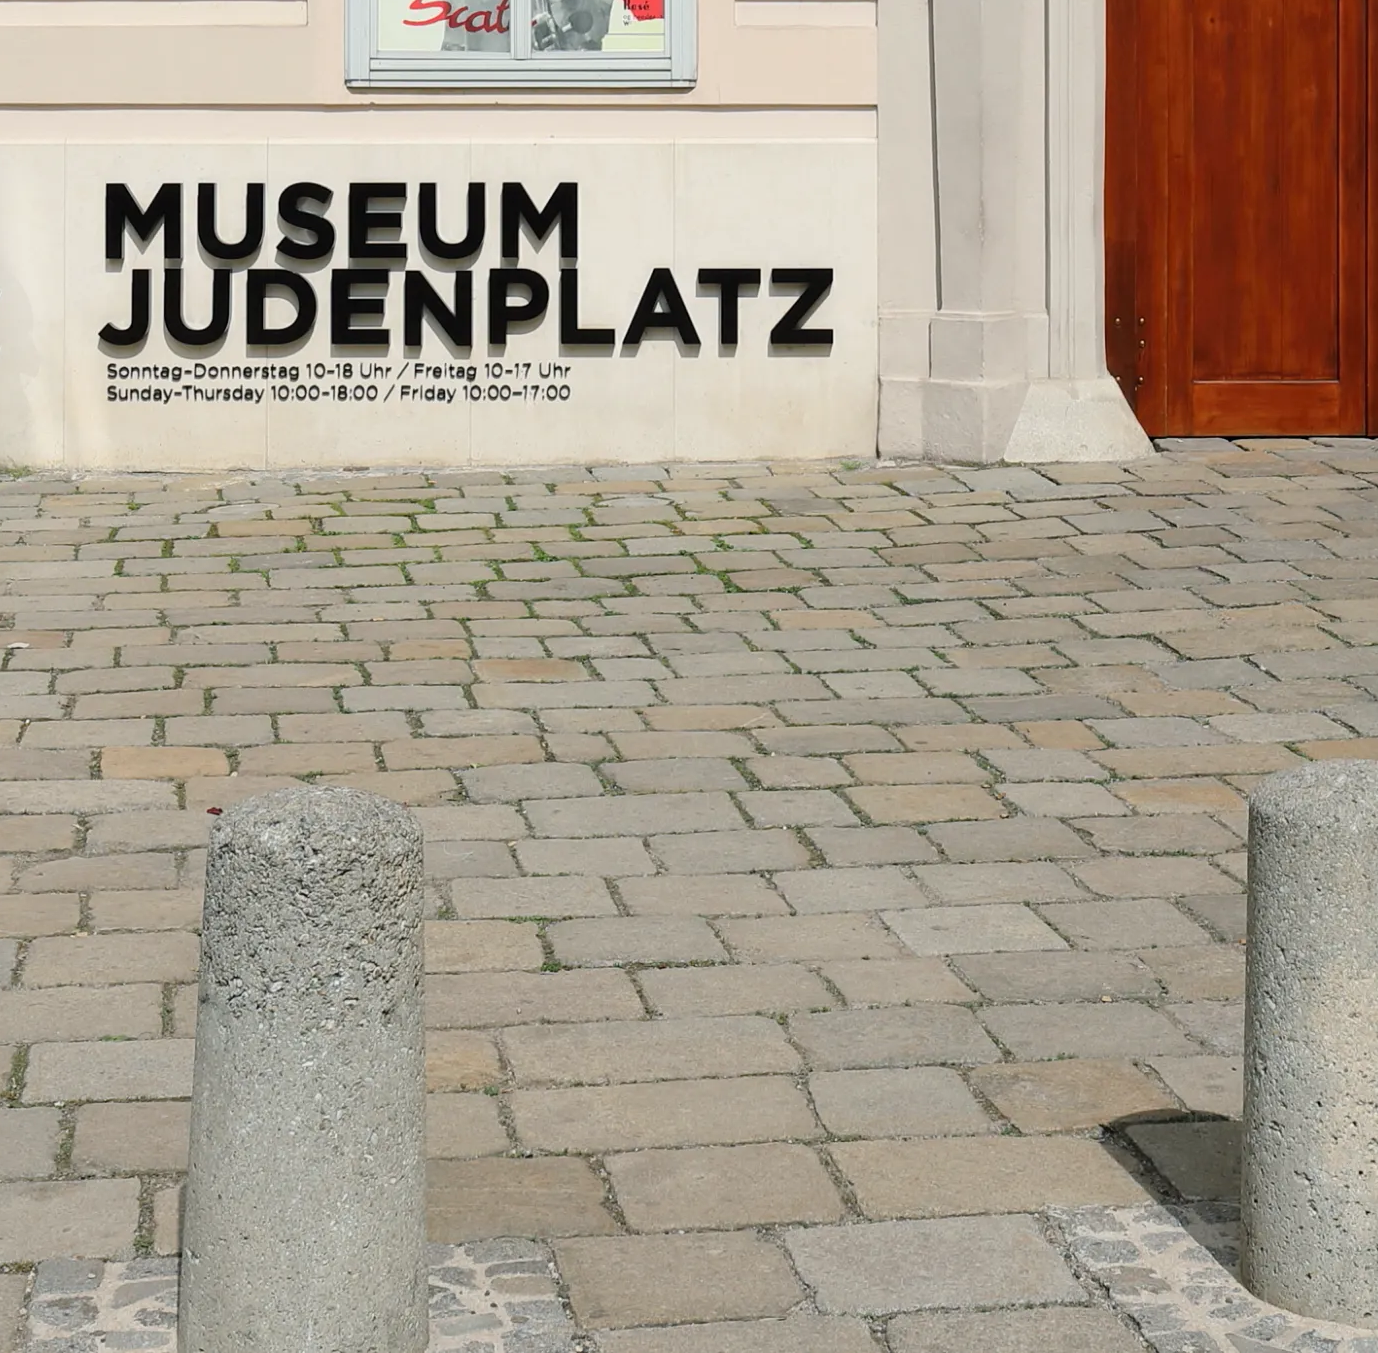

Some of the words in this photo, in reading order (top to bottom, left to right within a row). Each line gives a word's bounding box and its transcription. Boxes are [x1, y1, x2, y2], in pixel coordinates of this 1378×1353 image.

[105, 182, 577, 260] MUSEUM
[98, 268, 834, 346] JUDENPLATZ
[107, 363, 300, 382] Sonntag-Donnerstag
[306, 363, 353, 379] 10-18
[360, 363, 392, 379] Uhr
[397, 362, 409, 380] /
[414, 363, 478, 382] Freitag
[485, 363, 532, 379] 10-17
[539, 363, 571, 379] Uhr
[107, 384, 265, 404] Sunday-Thursday
[271, 385, 378, 401] 10:00-18:00
[383, 384, 395, 403] /
[400, 384, 457, 404] Friday
[462, 385, 571, 401] 10:00-17:00
